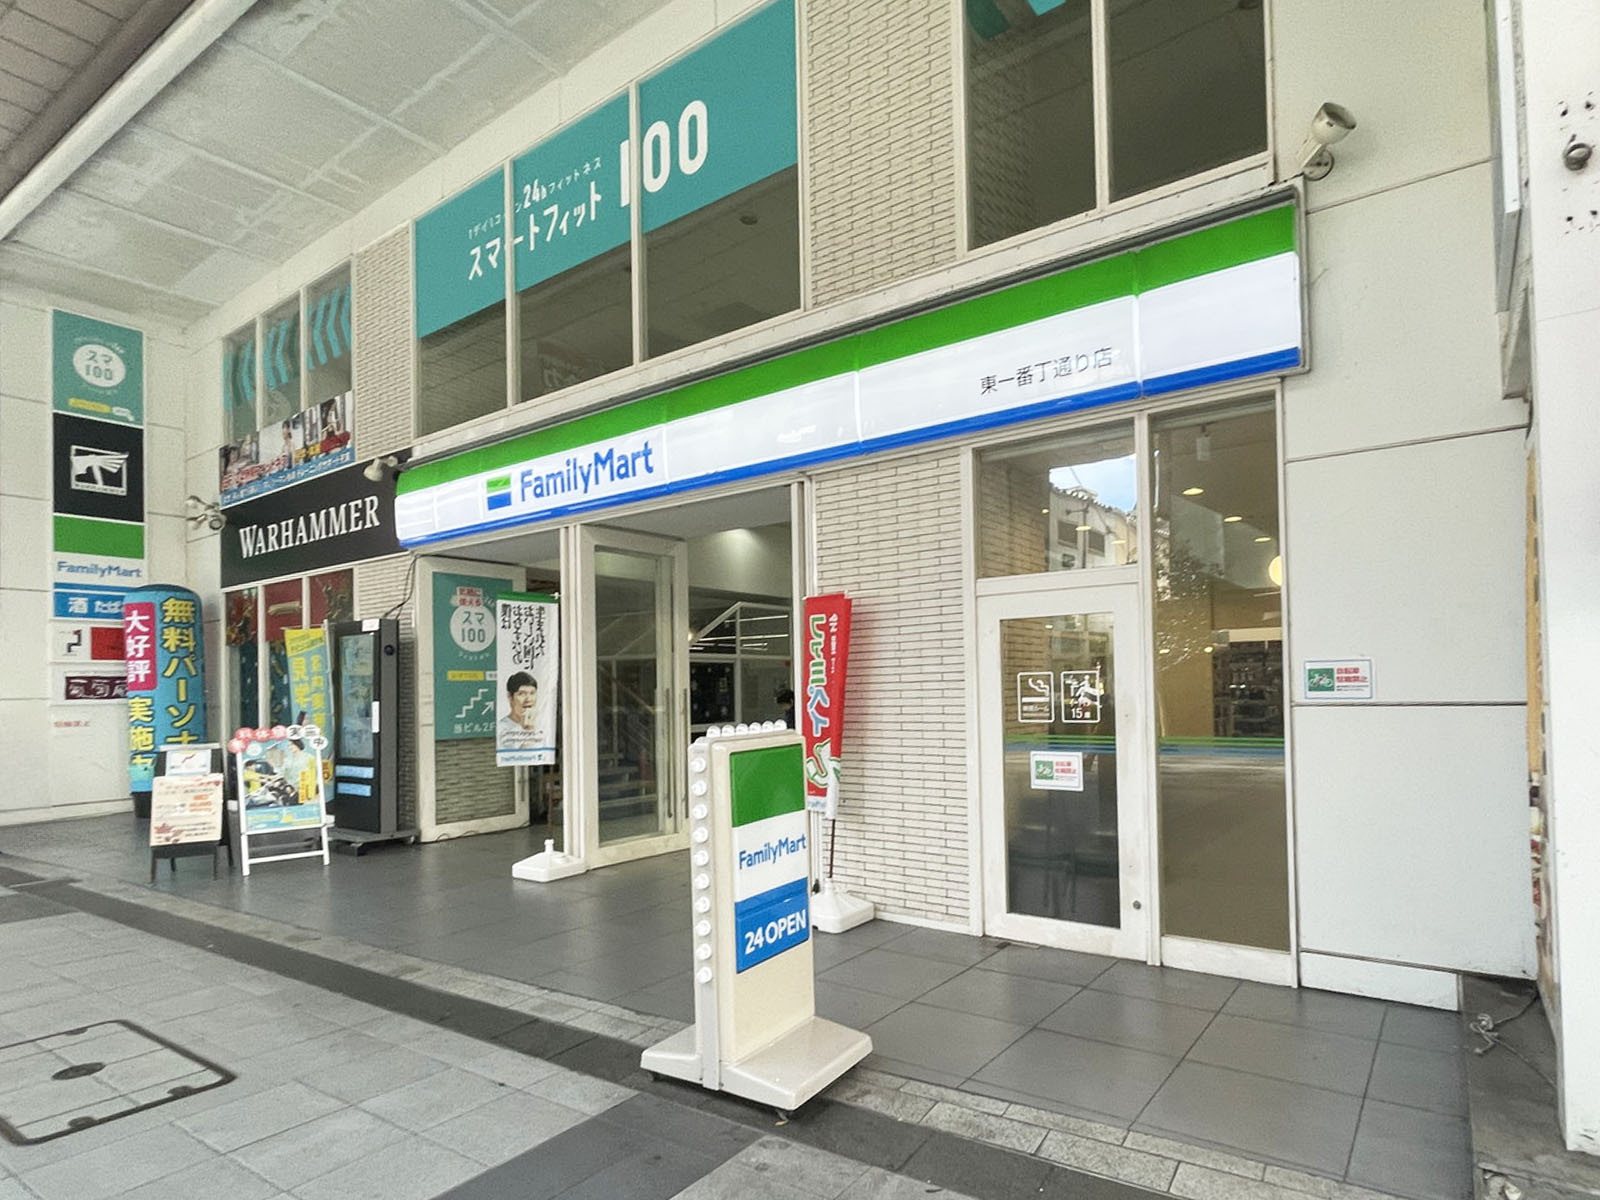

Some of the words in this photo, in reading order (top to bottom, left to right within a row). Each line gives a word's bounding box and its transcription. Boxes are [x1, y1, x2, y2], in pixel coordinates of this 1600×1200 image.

[619, 99, 709, 207] 100
[84, 365, 113, 381] 100
[980, 346, 1113, 395] 東一番丁通り店
[521, 441, 654, 502] FamilyMart
[239, 495, 380, 559] WARHAMMER
[57, 561, 143, 578] FamilyMart
[68, 597, 89, 613] 酒
[462, 611, 485, 625] スマ
[125, 610, 151, 683] 大好評
[461, 628, 485, 643] 100
[739, 833, 807, 870] FamilyMart
